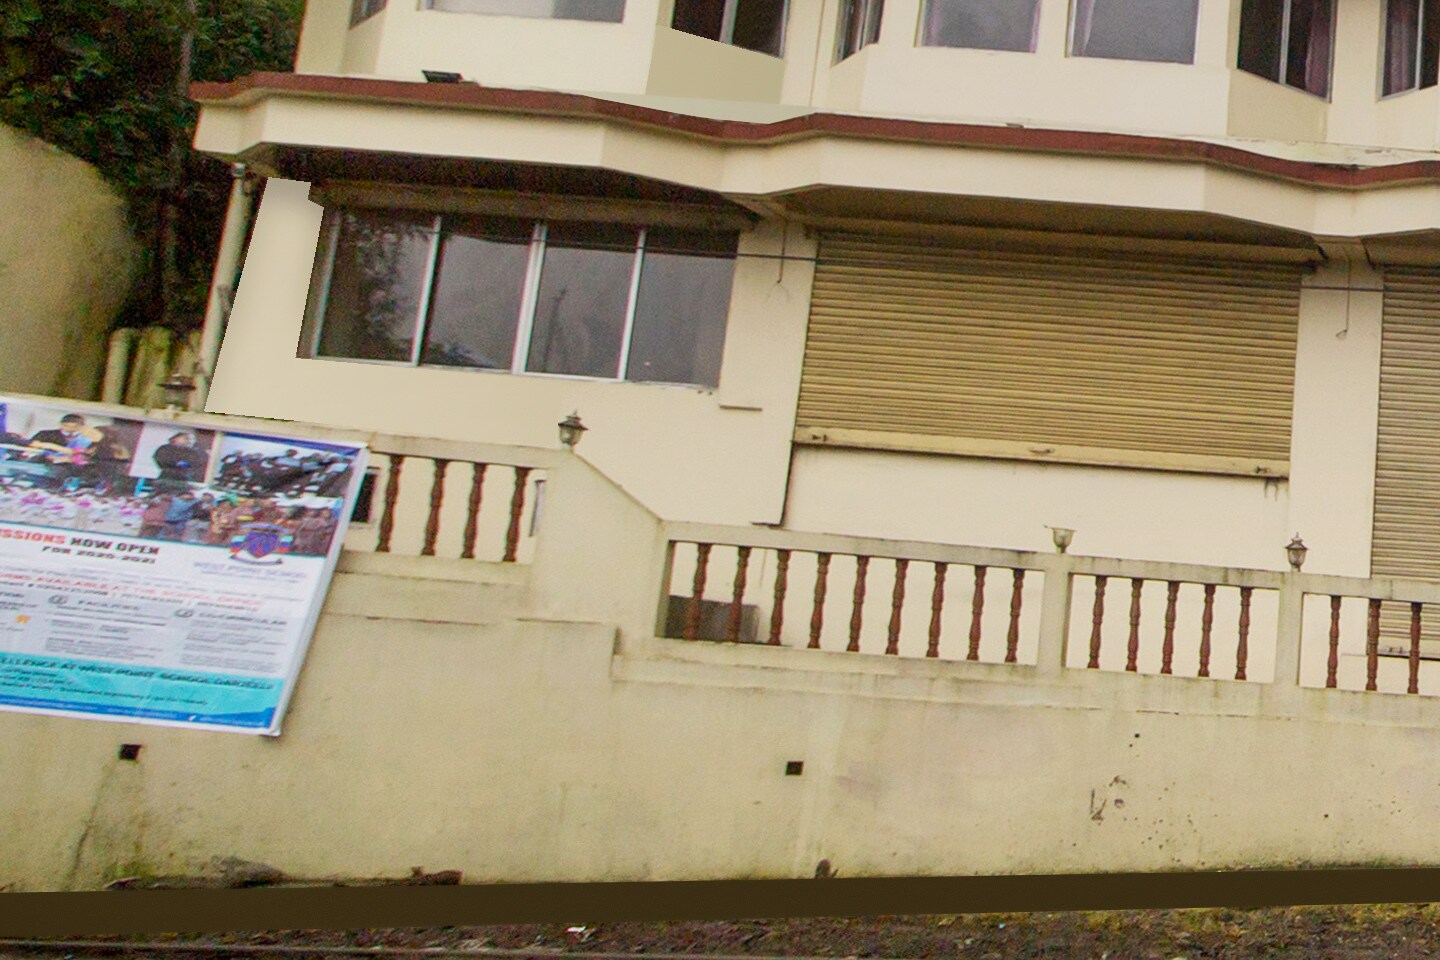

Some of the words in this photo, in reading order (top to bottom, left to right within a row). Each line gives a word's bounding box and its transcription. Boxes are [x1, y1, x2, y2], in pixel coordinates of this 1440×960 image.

[42, 546, 71, 554] FOR
[70, 537, 113, 550] NOW
[116, 541, 160, 555] OPEN
